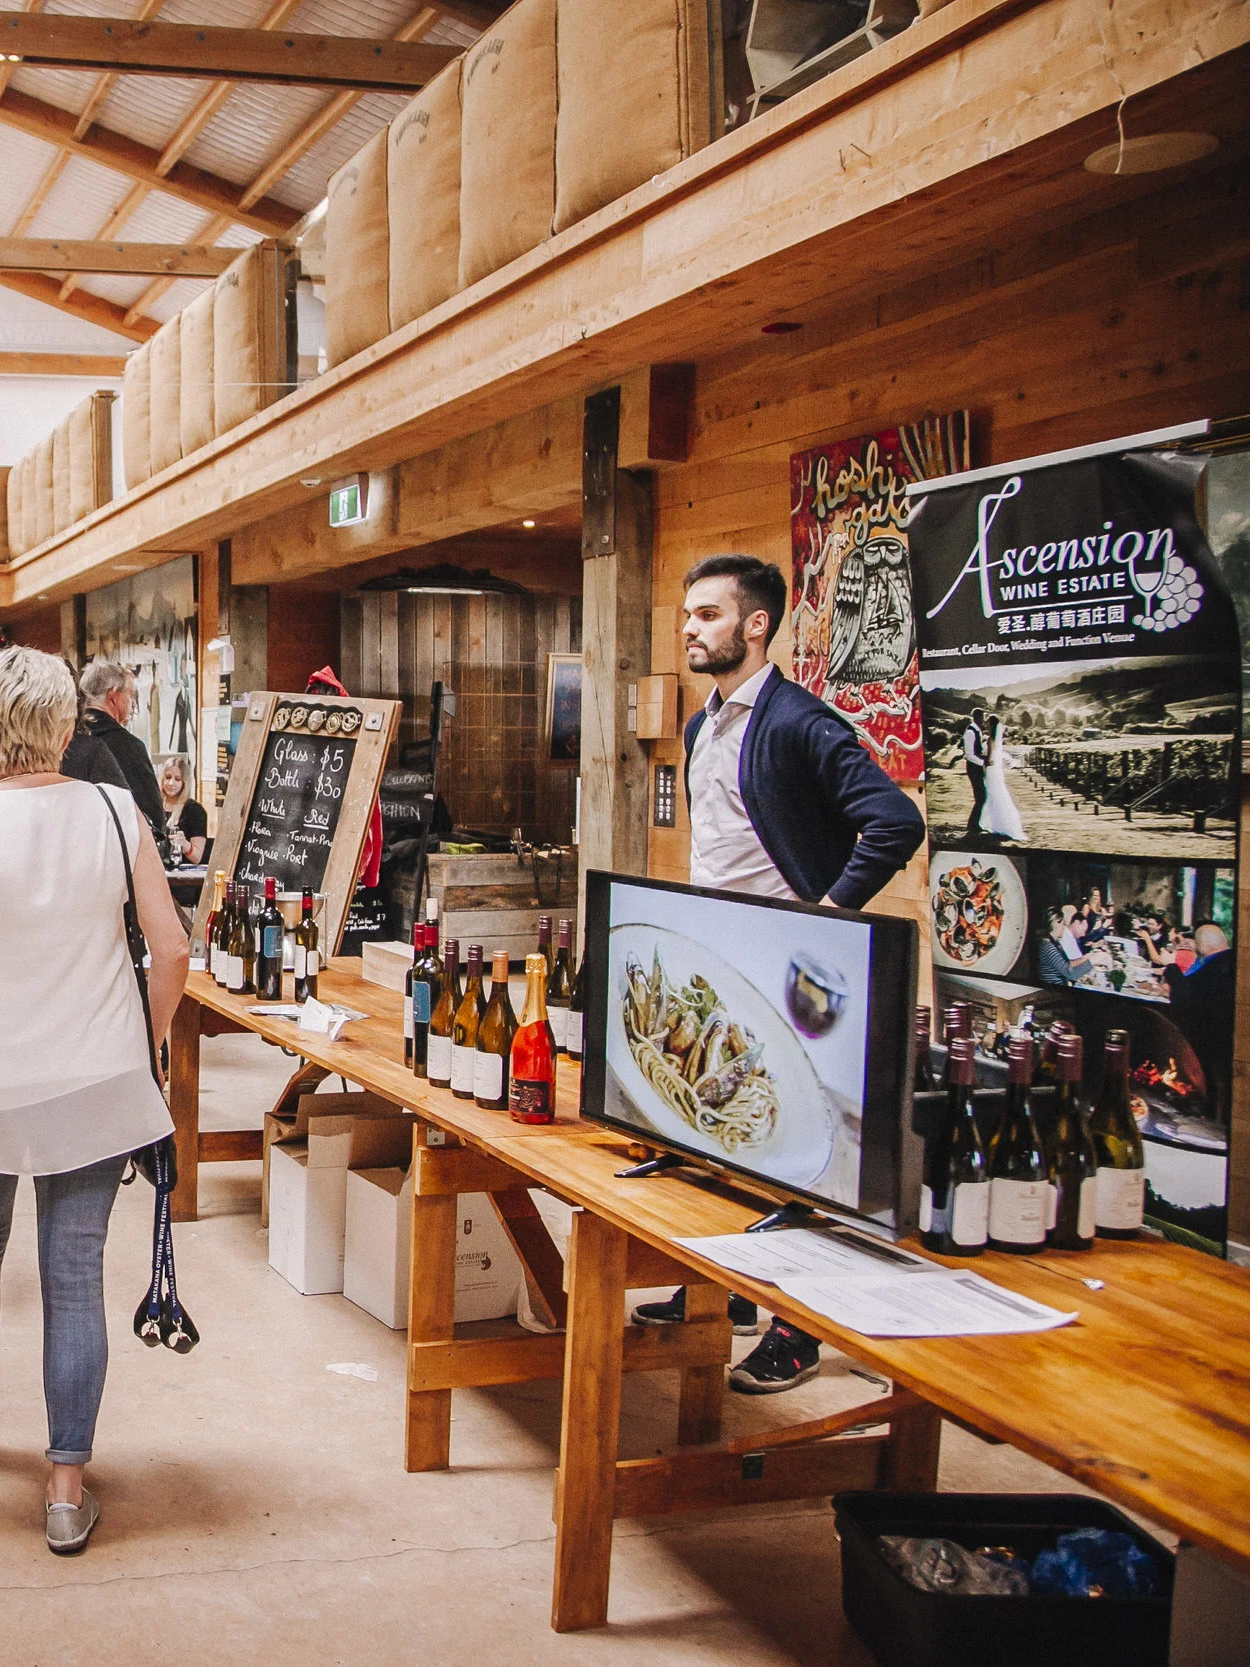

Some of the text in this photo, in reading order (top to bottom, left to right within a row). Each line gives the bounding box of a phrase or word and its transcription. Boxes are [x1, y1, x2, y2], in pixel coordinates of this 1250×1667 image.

[926, 476, 1175, 618] Ascension
[1000, 572, 1126, 601] WINE ESTATE
[961, 643, 986, 655] Cellar
[987, 642, 1010, 653] Door,
[1010, 639, 1047, 652] Wedding
[1048, 636, 1064, 648] and
[1065, 635, 1102, 647] Function
[1102, 632, 1135, 643] Venue
[274, 738, 308, 764] Glass
[320, 745, 344, 772] $5
[314, 772, 341, 800] $30
[258, 798, 285, 816] White
[304, 809, 329, 826] Red
[160, 1194, 168, 1222] FESTIVAL
[158, 1223, 166, 1240] WINE
[152, 1269, 161, 1303] MATAKANA
